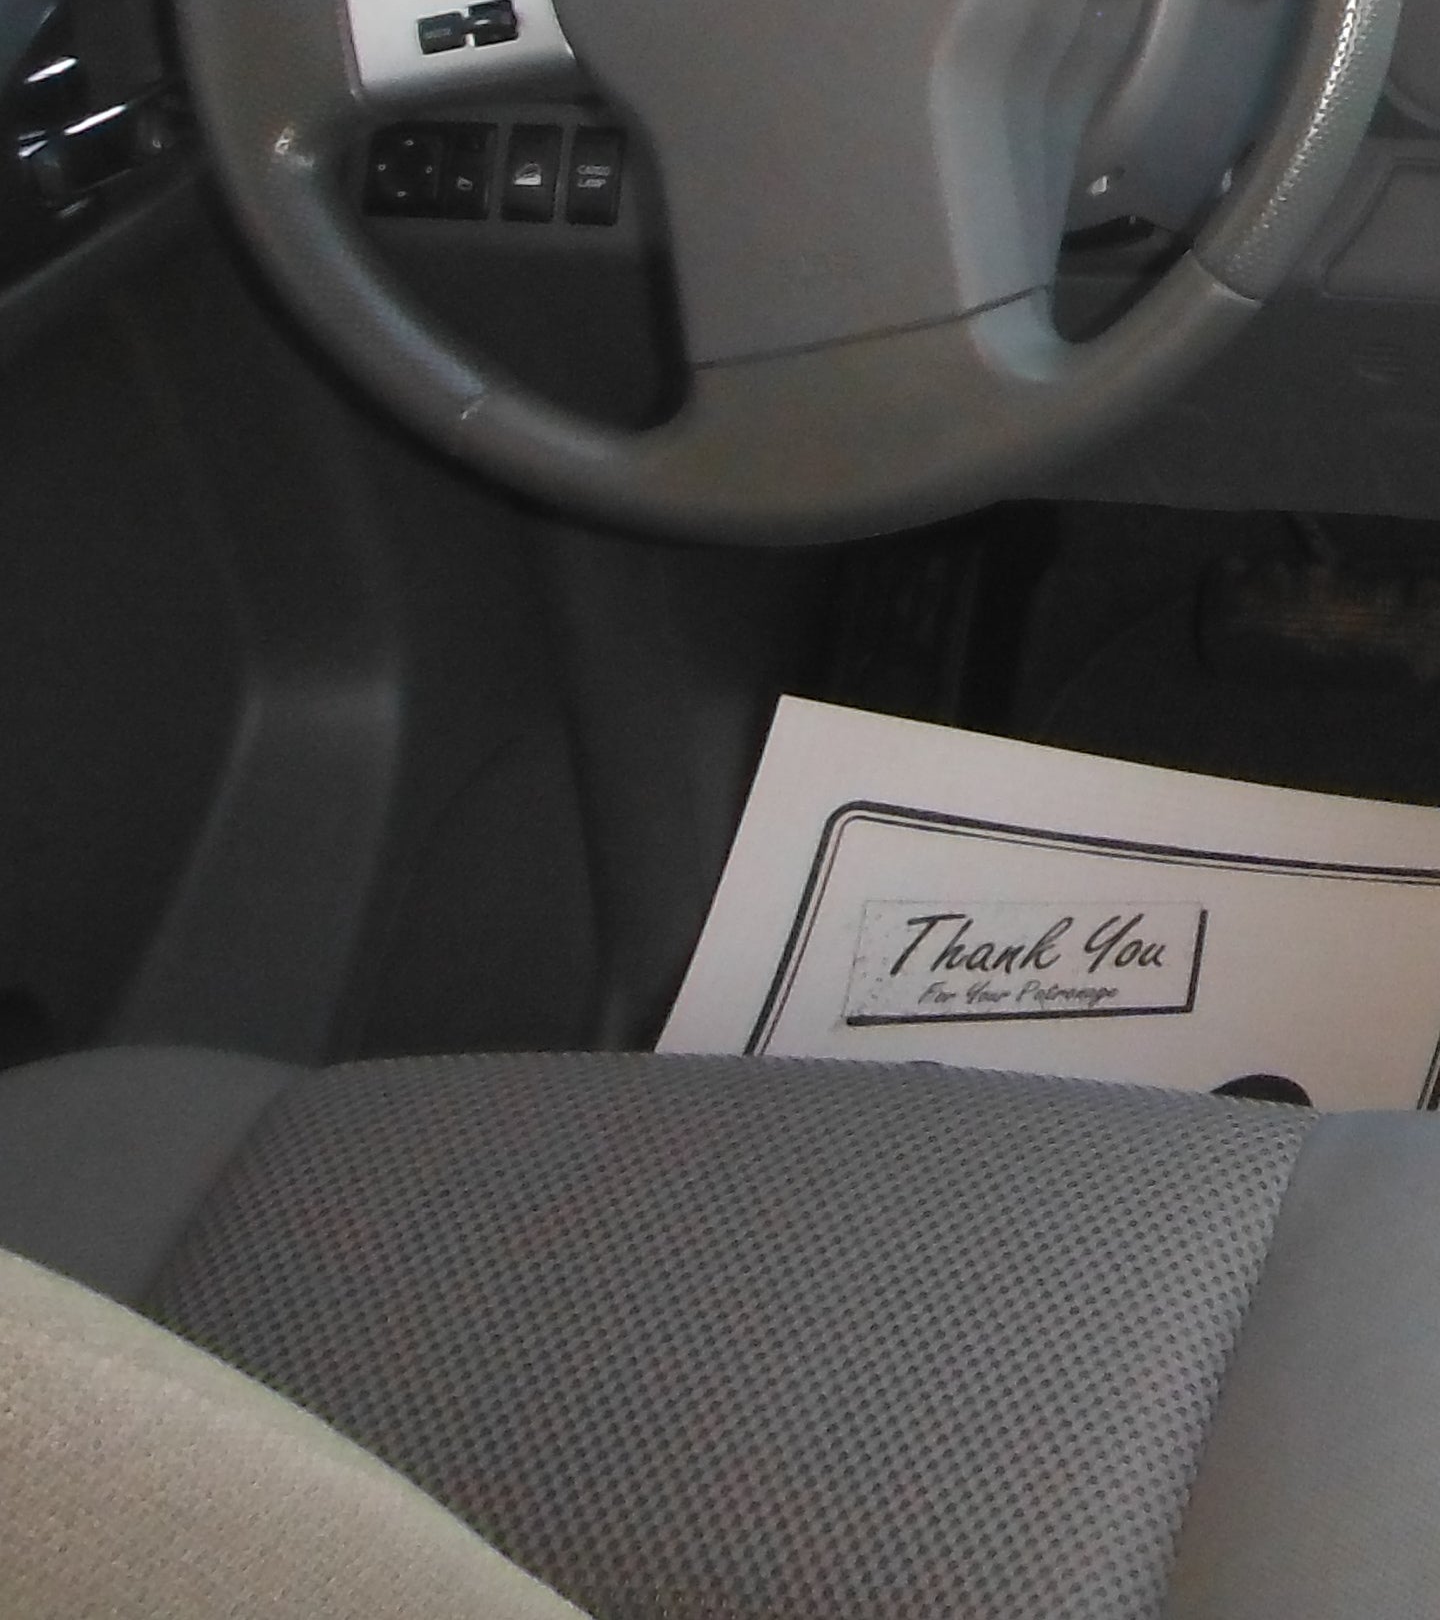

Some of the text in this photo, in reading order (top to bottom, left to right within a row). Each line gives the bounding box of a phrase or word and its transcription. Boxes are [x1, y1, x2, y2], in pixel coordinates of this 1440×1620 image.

[888, 912, 1168, 978] Thank You
[916, 980, 957, 1006] For
[965, 980, 1011, 1005] Your
